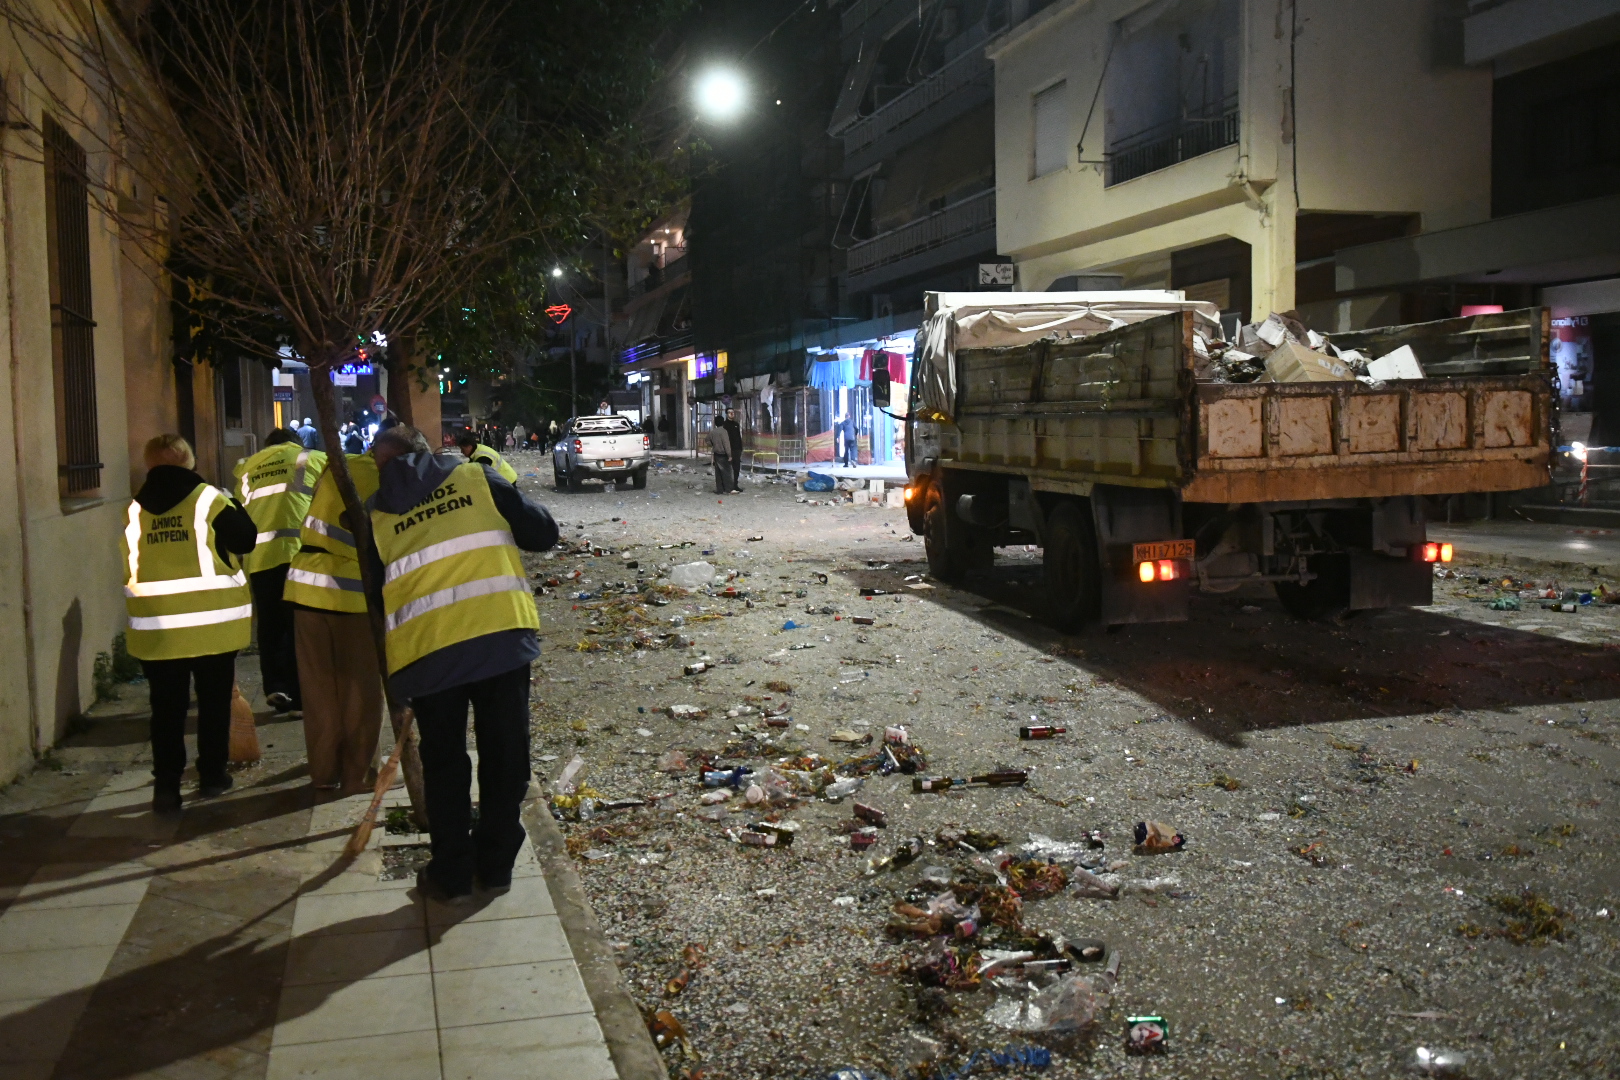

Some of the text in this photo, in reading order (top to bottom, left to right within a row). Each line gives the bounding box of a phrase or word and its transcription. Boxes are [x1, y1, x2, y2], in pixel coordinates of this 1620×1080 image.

[257, 459, 285, 470] ΔΗΜΟΣ
[251, 469, 288, 483] ΠΑΤΡΕΩΝ
[399, 483, 457, 516] ΜΟΣ
[393, 494, 473, 535] ΠΑΤΡΕΩΝ
[151, 515, 183, 530] ΔΗΜΟΣ
[146, 530, 189, 544] ΠΑΤΡΕΩΝ
